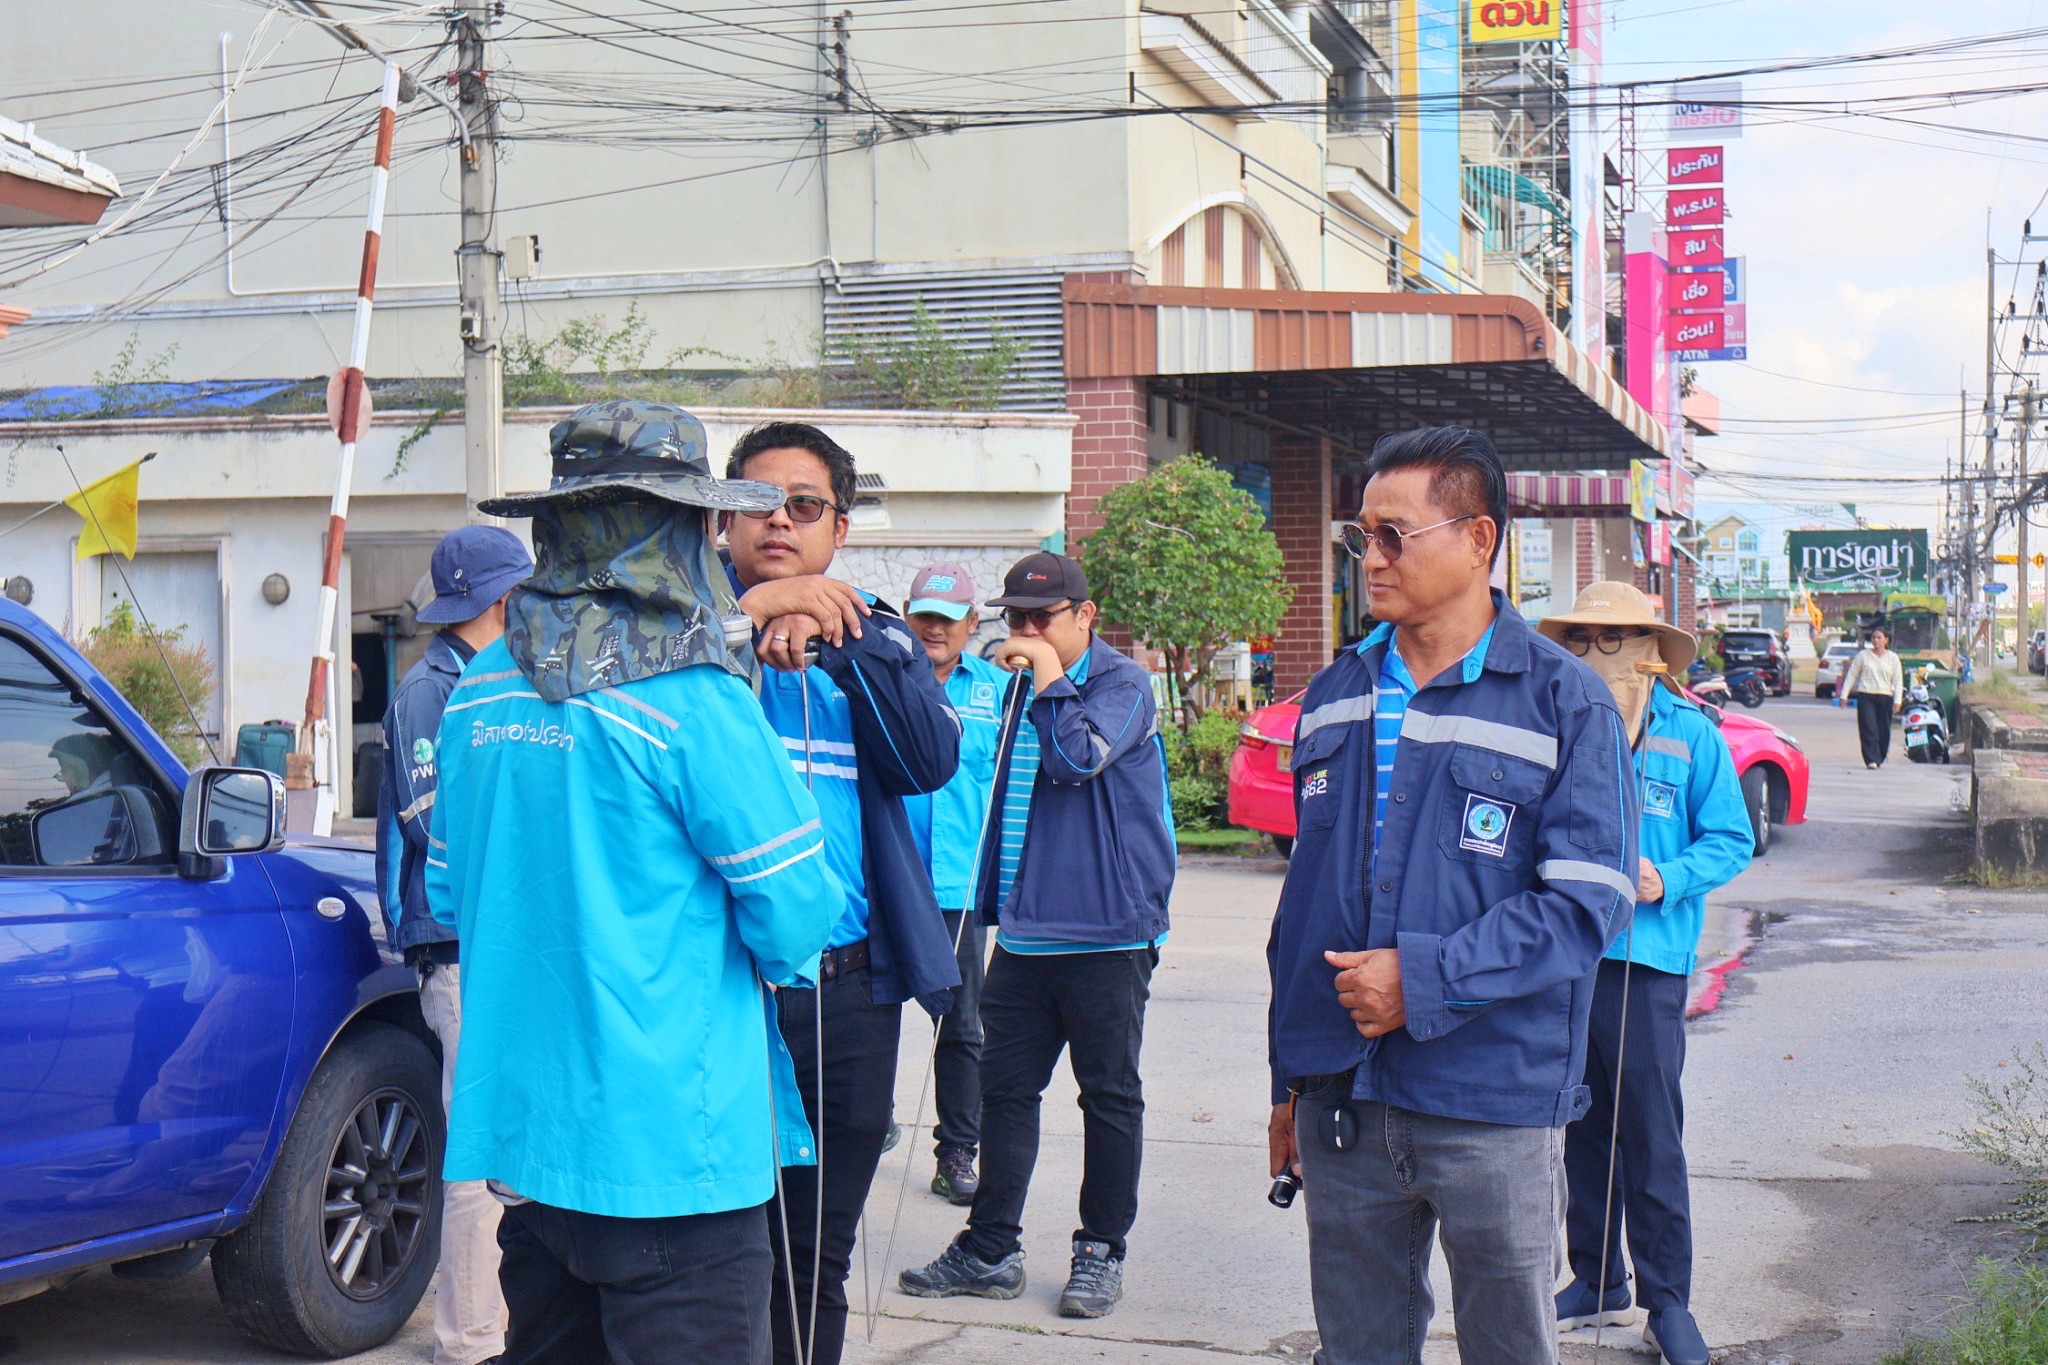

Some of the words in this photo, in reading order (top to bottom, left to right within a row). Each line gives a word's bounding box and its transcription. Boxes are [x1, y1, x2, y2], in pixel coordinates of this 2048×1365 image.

[1671, 153, 1719, 177] ประกัน
[1673, 196, 1719, 218] พ.ร.บ.
[1682, 279, 1709, 301] เชื่อ
[1677, 320, 1715, 342] ด่วน!
